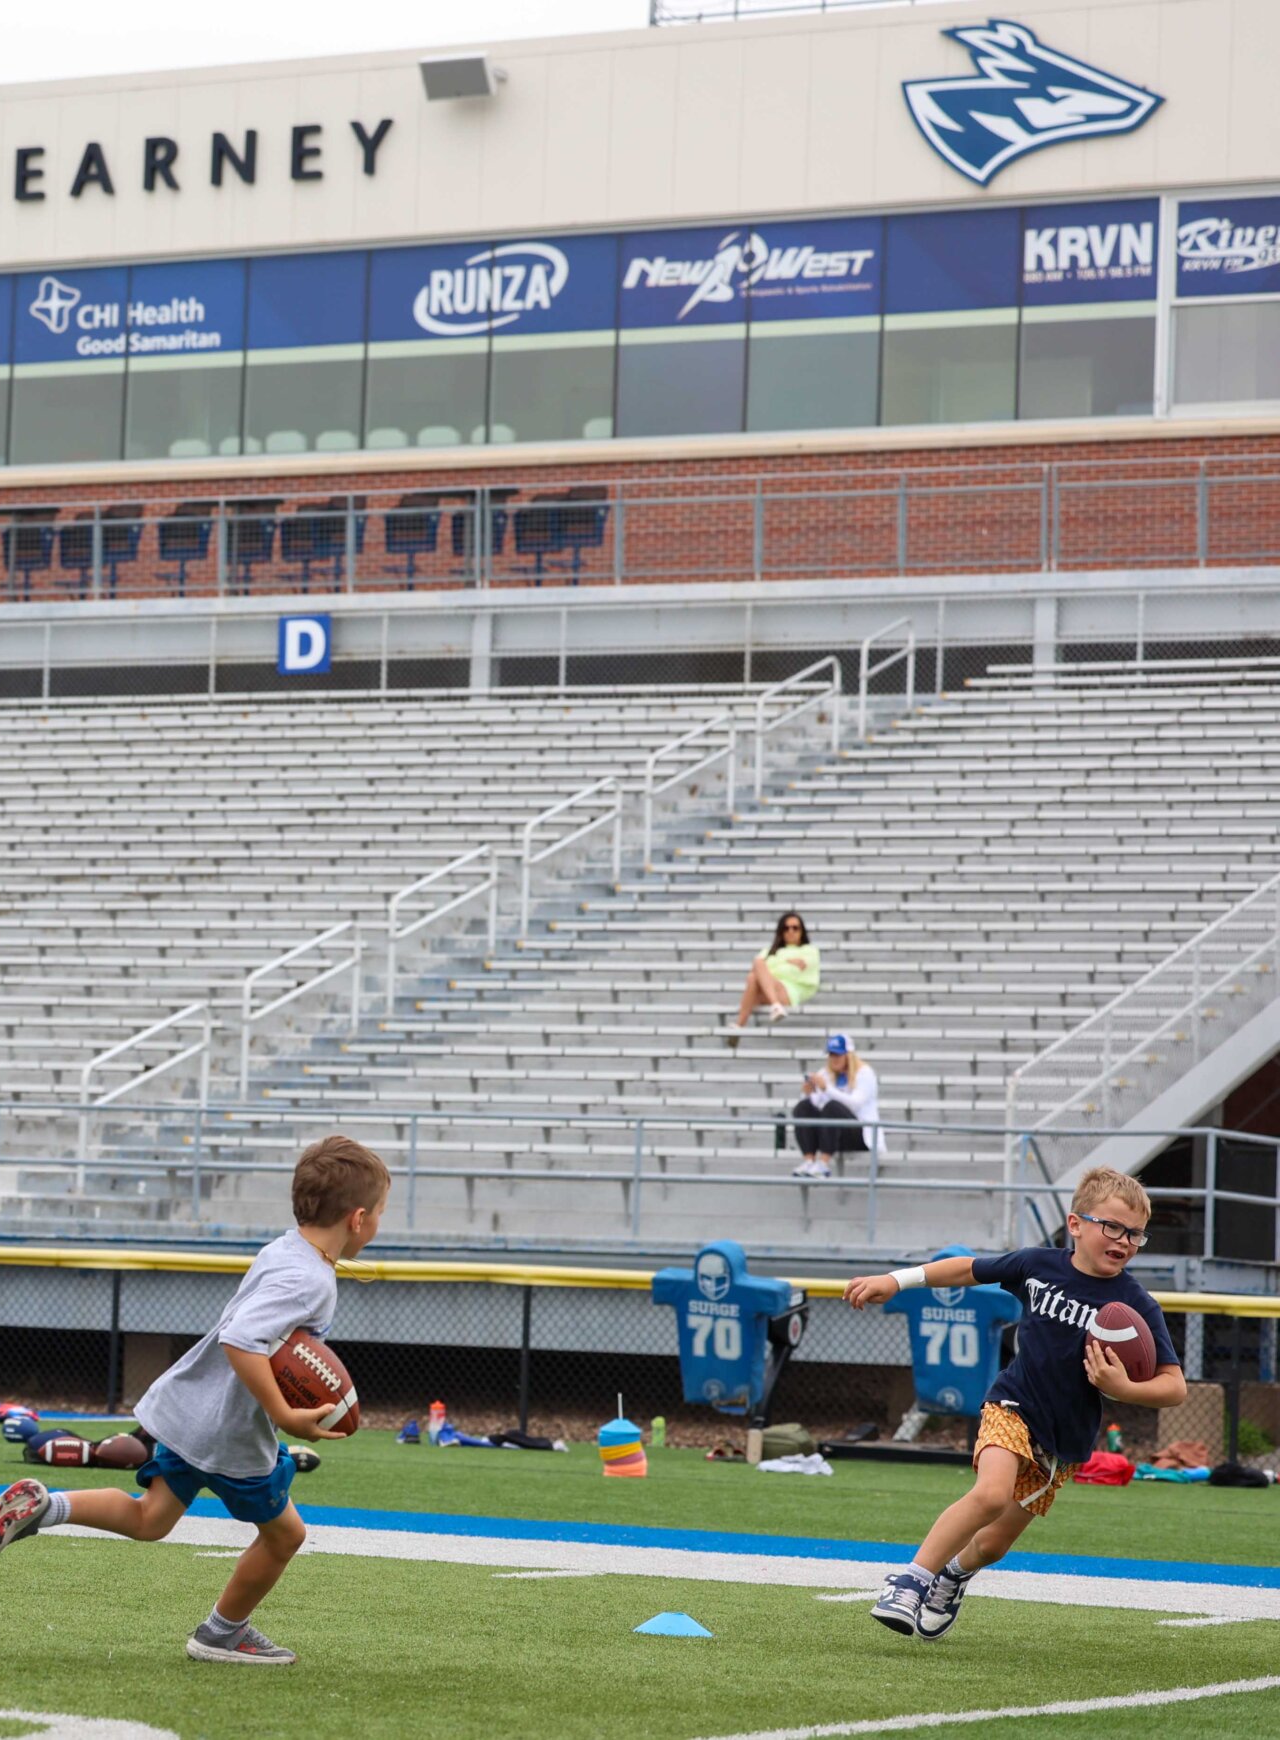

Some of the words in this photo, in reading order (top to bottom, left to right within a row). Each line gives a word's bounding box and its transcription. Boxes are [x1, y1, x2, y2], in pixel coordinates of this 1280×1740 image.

[1023, 222, 1153, 271] KRVN
[429, 263, 551, 316] RUNZA
[76, 303, 120, 330] CHI
[127, 296, 205, 327] Health
[76, 333, 127, 356] Good
[129, 329, 222, 352] Samaritan
[285, 619, 326, 670] D
[688, 1300, 740, 1317] SURGE
[921, 1306, 977, 1323] SURGE
[686, 1314, 742, 1361] 70
[919, 1322, 979, 1368] 70
